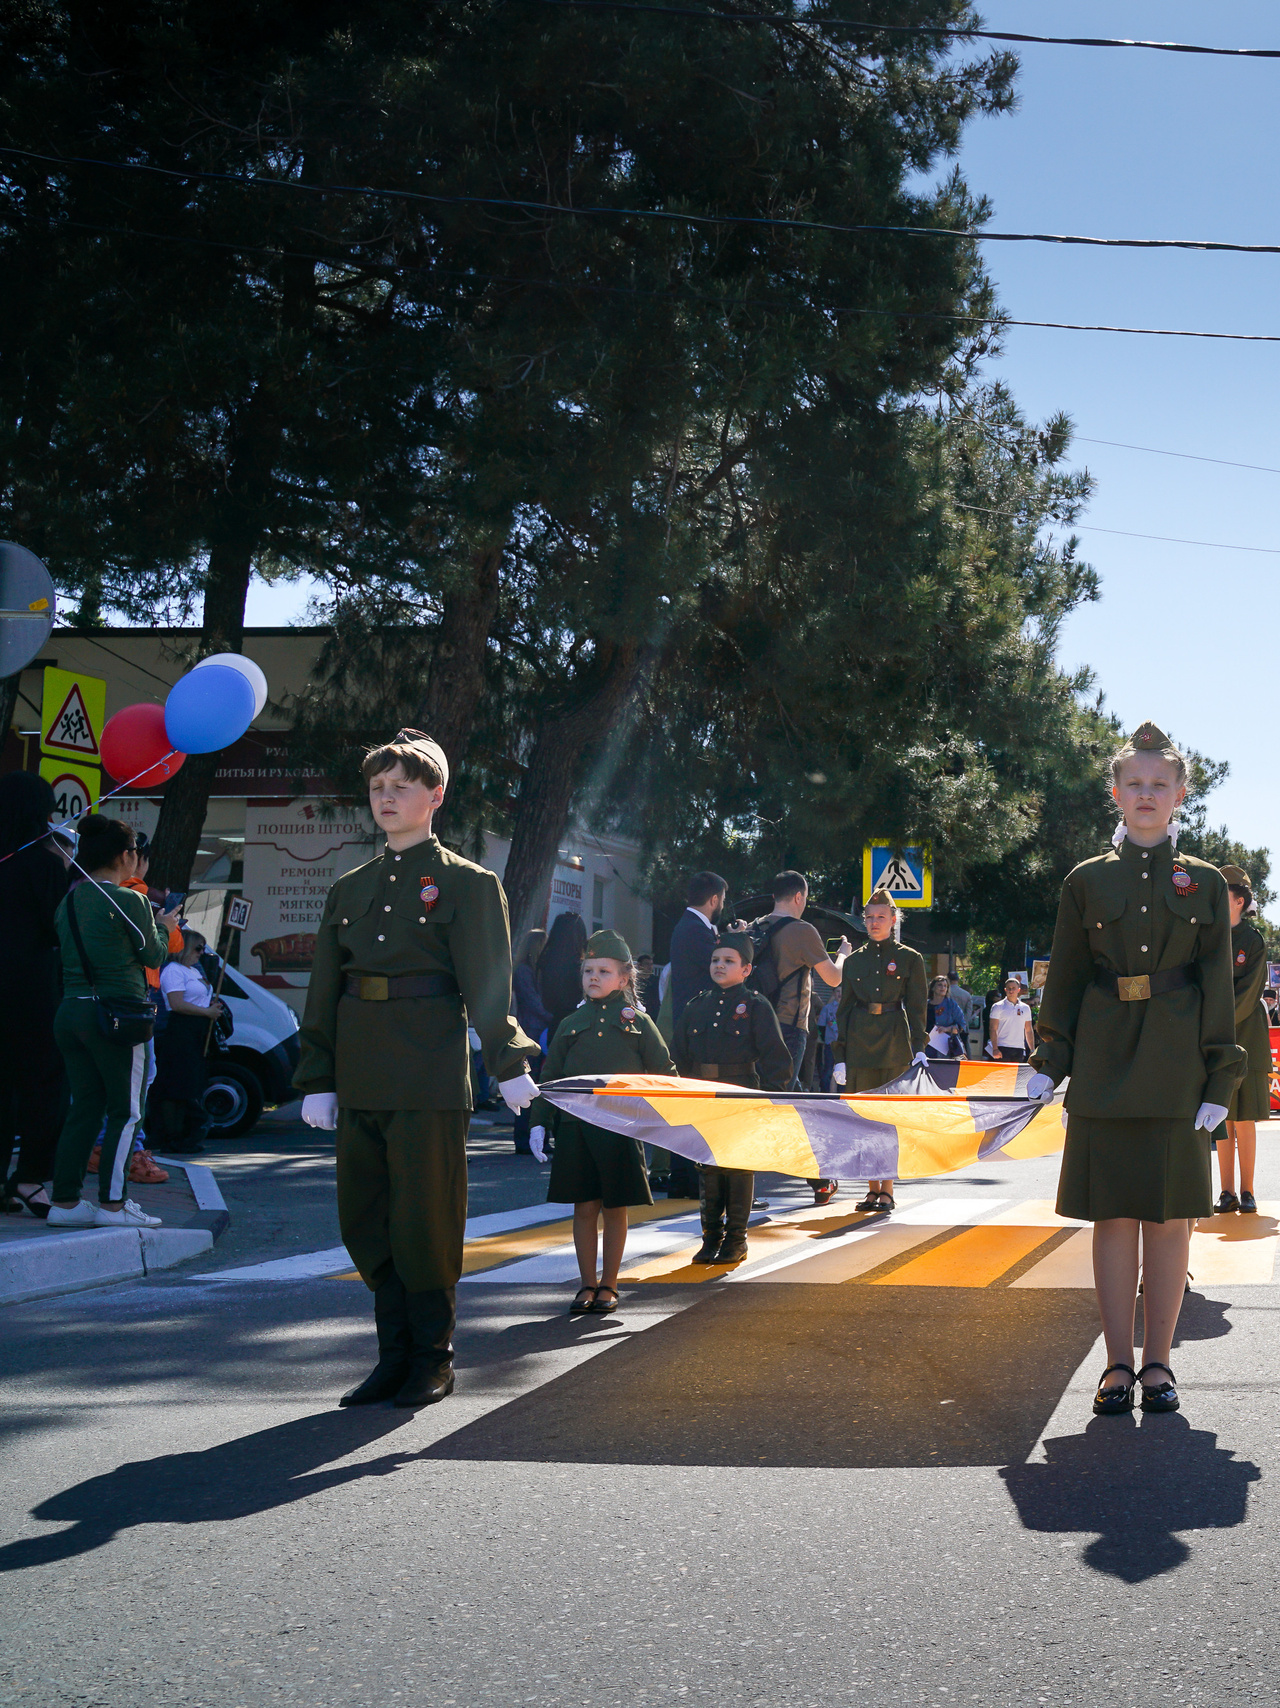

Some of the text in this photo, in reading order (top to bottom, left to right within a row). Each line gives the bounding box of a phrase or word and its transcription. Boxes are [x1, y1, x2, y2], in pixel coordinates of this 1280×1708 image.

[257, 768, 267, 778] И
[269, 768, 326, 778] РУКОДЕЛ
[55, 793, 82, 820] 40
[257, 823, 362, 835] ПОШИВ ШТОР
[280, 868, 335, 877] РЕМОНТ
[267, 886, 329, 895] ПЕРЕТЯЖ
[553, 879, 582, 899] ШТОРЫ
[279, 900, 326, 909] МЯГКО
[279, 913, 322, 922] МЕБЕЛ
